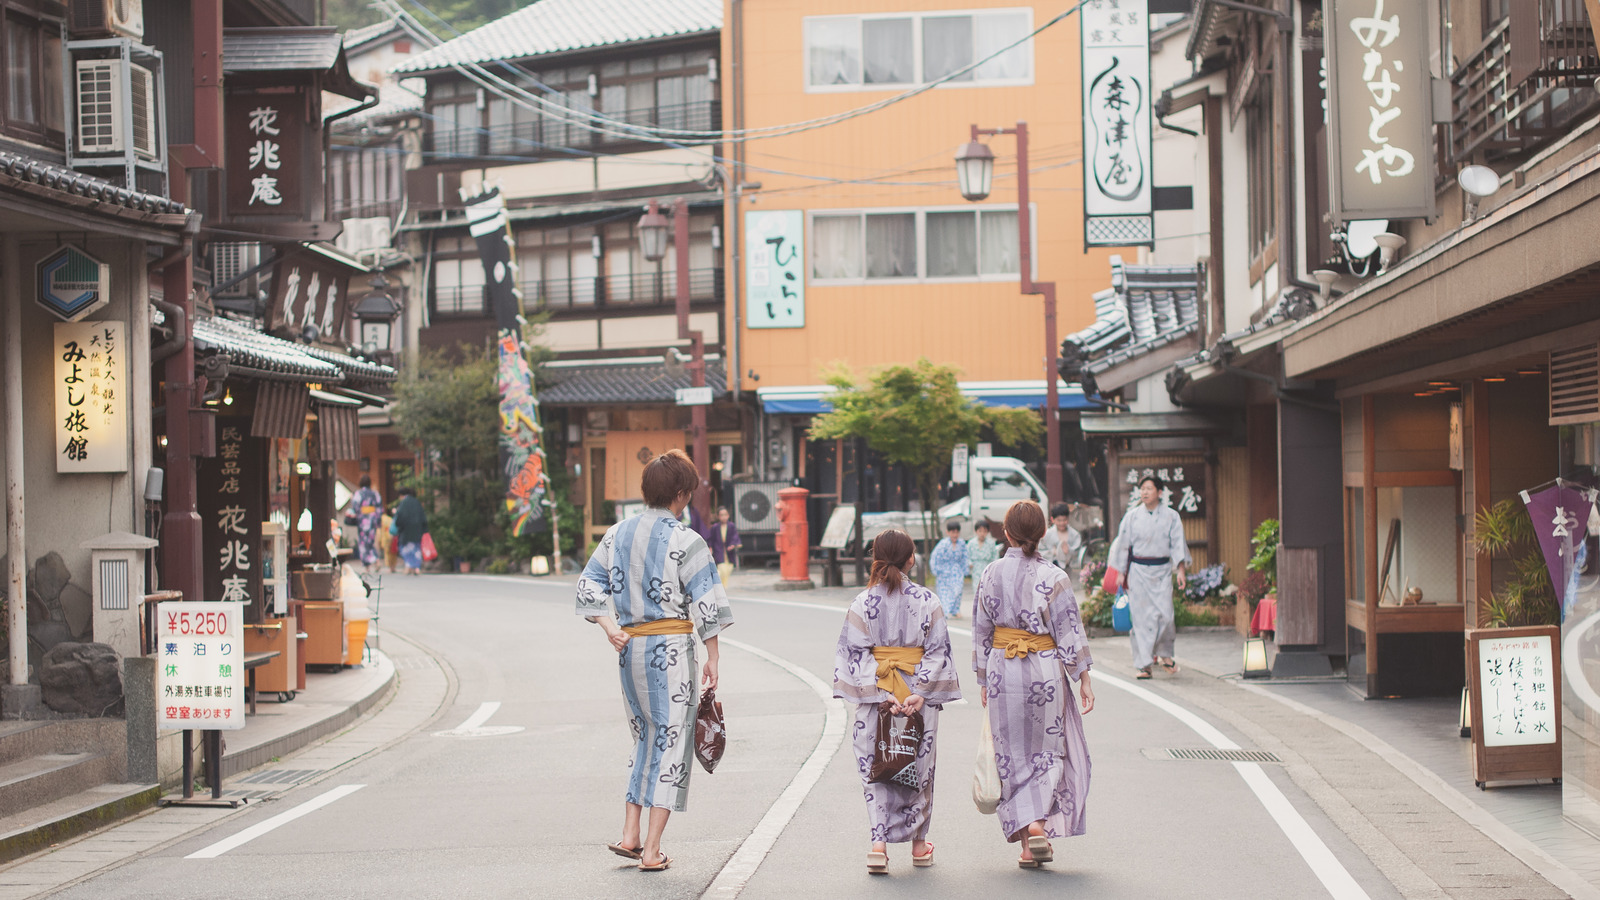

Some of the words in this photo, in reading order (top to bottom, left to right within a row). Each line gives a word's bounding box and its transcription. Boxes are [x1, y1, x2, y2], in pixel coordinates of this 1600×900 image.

[1350, 0, 1415, 184] みなとや
[248, 106, 283, 206] 花兆庵
[765, 236, 798, 320] ひらい
[62, 341, 90, 462] みよし旅館
[89, 335, 102, 408] 天然温泉の
[218, 426, 242, 494] 民芸品店
[217, 504, 252, 606] 花兆庵
[165, 643, 232, 656] 素泊り
[167, 611, 227, 635] ¥5,250
[165, 664, 232, 677] 休憩
[165, 685, 232, 698] 外湯券駐車場付
[165, 706, 232, 719] 空室あります
